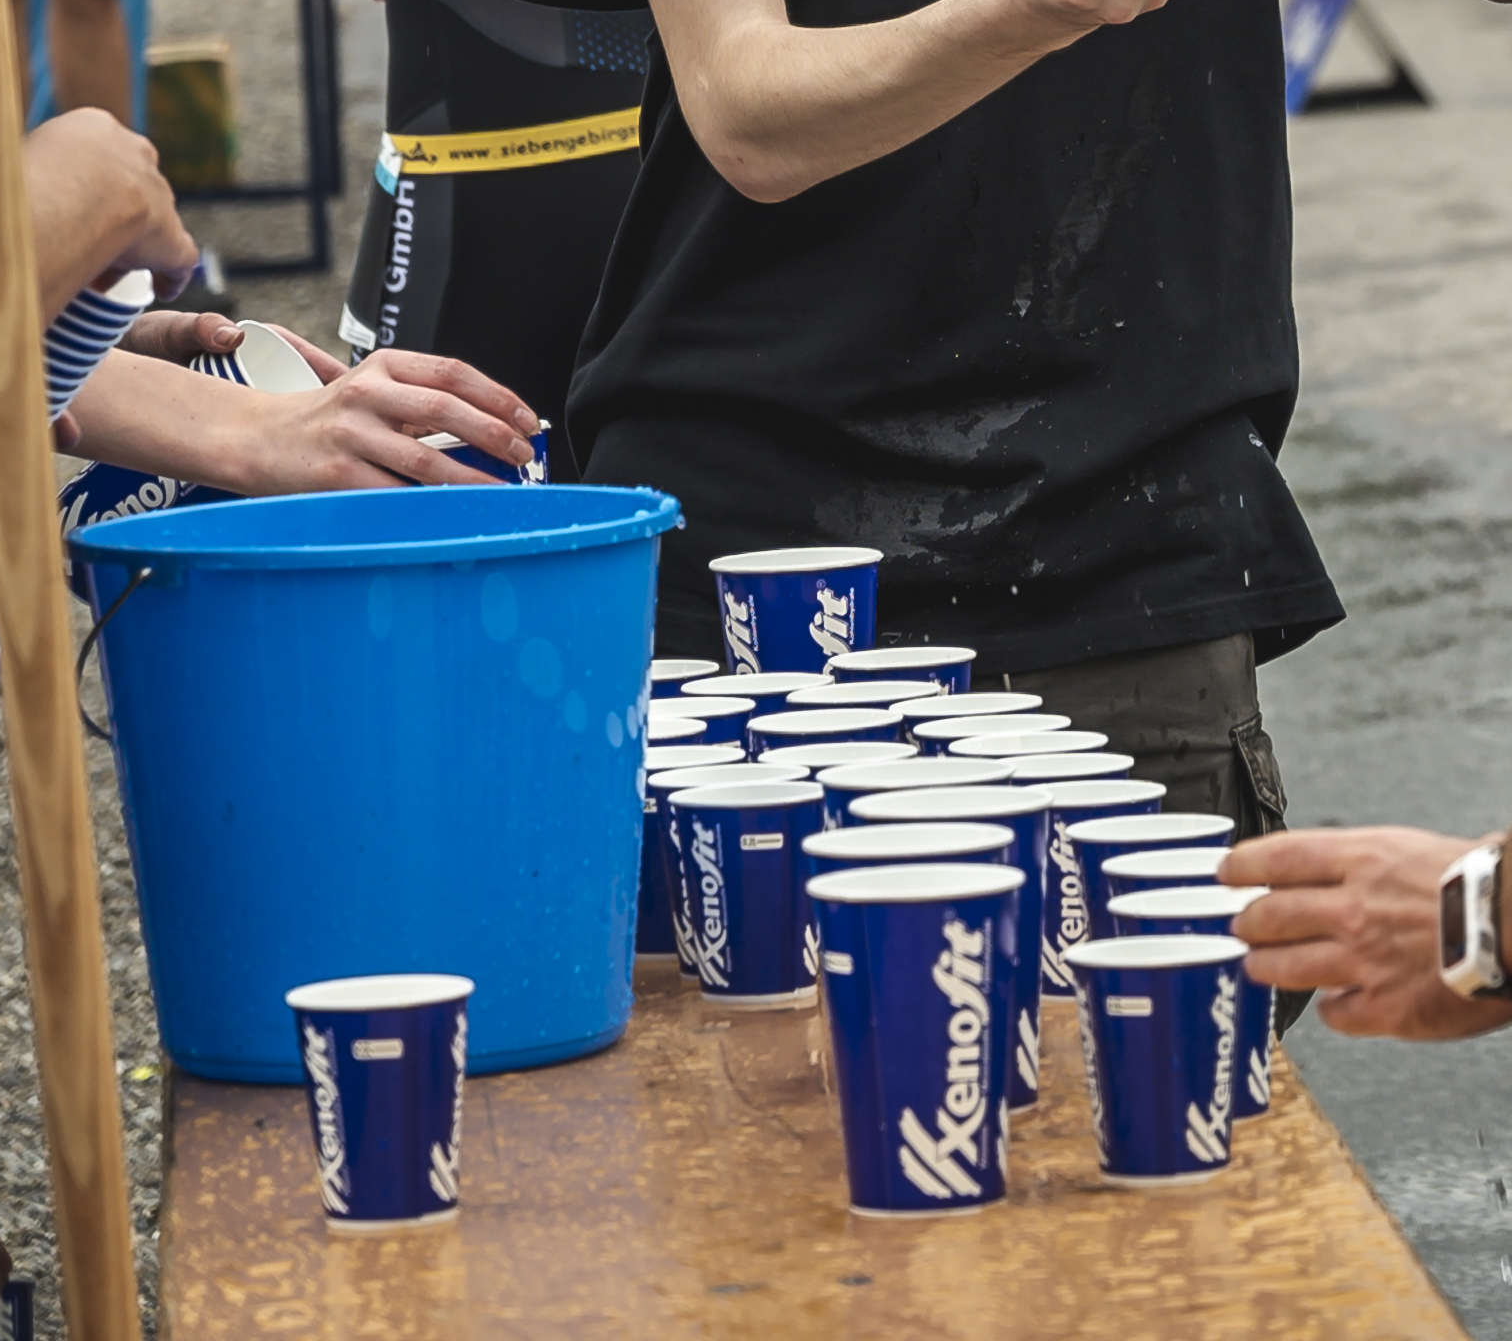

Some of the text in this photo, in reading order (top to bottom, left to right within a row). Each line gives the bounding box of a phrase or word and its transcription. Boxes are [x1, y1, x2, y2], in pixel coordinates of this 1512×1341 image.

[384, 179, 416, 293] GmbH
[692, 820, 730, 987] Xenofit
[304, 1022, 350, 1214] Xenofit
[900, 917, 988, 1199] Xenofit
[1186, 973, 1237, 1163] Xenofit
